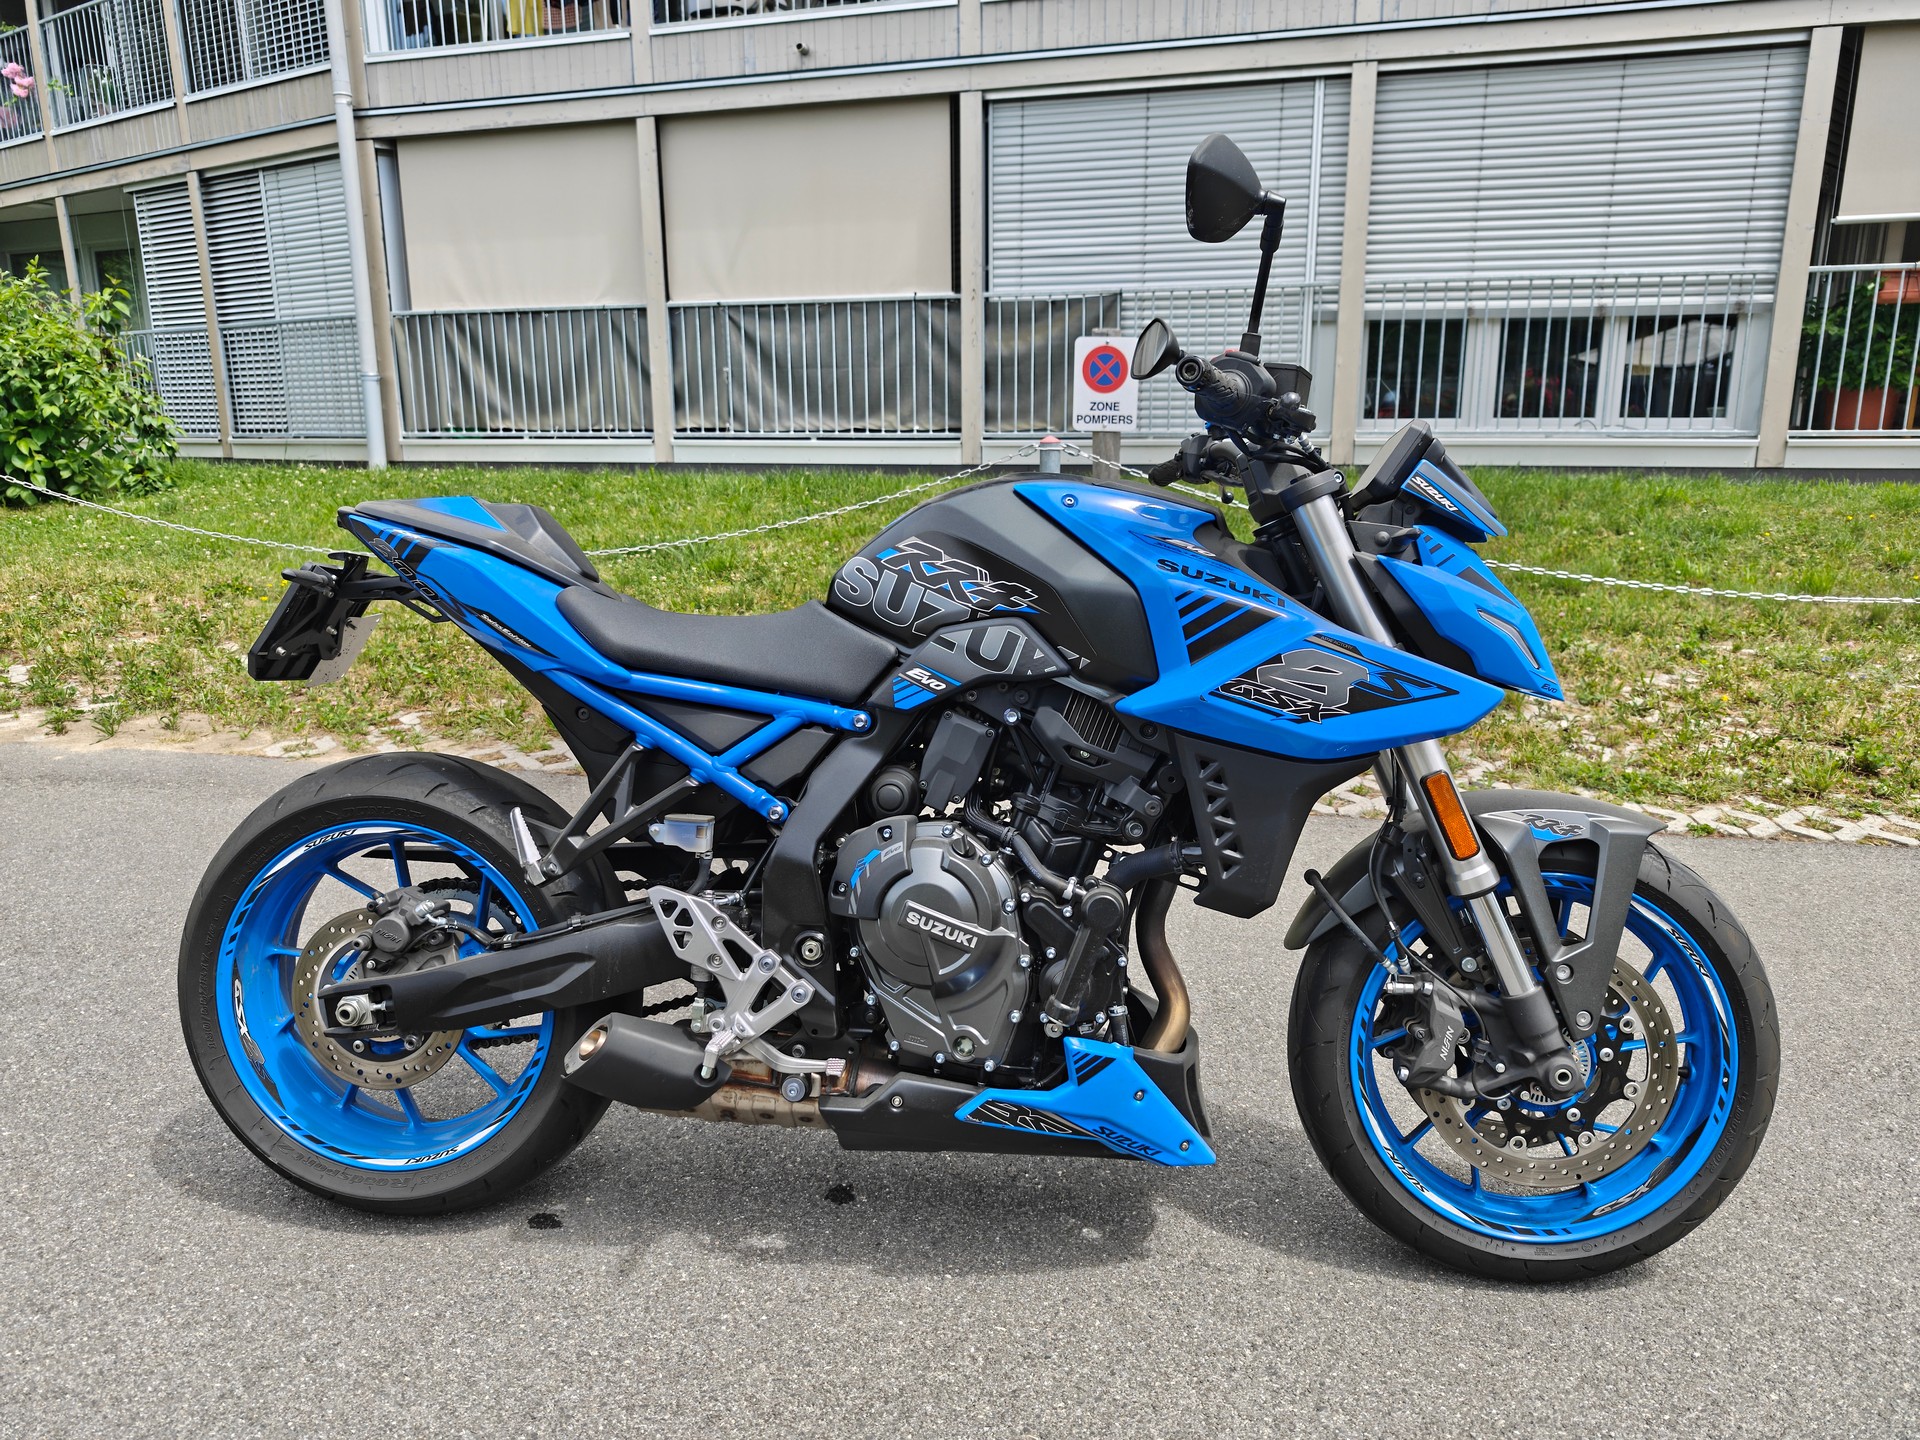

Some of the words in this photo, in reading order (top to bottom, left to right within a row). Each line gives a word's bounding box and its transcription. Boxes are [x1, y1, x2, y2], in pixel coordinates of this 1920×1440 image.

[1076, 414, 1133, 425] POMPIERS
[1089, 401, 1120, 412] ZONE
[1411, 476, 1459, 511] SUZUKI
[1155, 558, 1287, 608] SUZUKI
[303, 828, 358, 852] SUZUKI
[906, 911, 979, 949] SUZUKI
[1666, 928, 1711, 979] SUZUKI
[1439, 1025, 1455, 1061] NISSIN
[404, 1145, 460, 1165] SUZUKI
[1093, 1125, 1163, 1157] SUZUKI
[1383, 1145, 1430, 1193] SUZUKI
